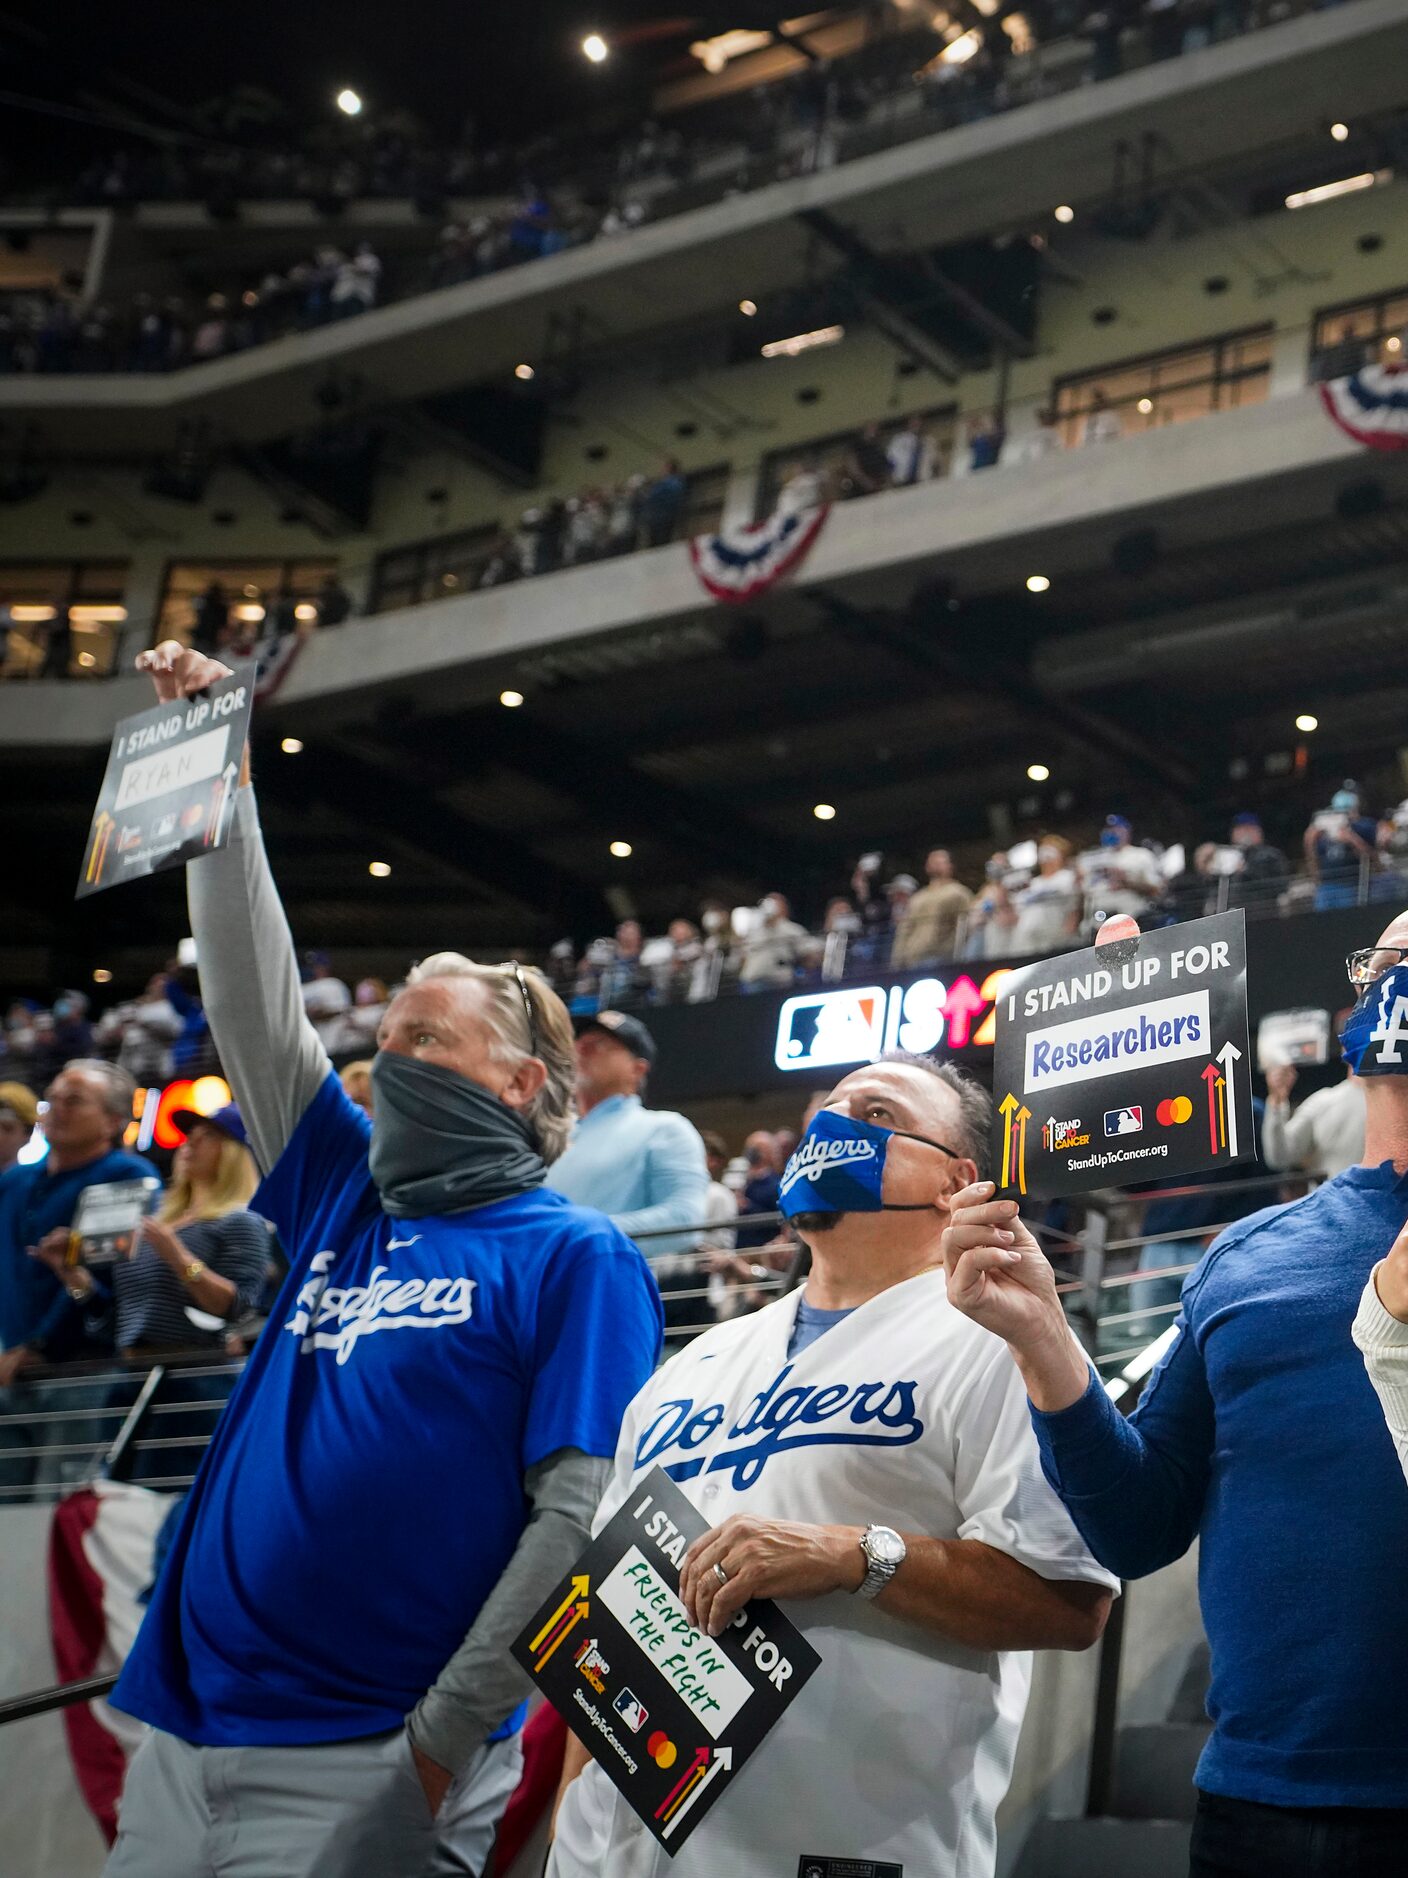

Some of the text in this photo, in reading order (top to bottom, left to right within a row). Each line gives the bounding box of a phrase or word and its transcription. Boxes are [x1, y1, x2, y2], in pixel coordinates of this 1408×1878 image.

[117, 687, 247, 759] I STAND UP FOR
[126, 755, 191, 797] RYAN
[1008, 941, 1231, 1022] I STAND UP FOR
[1032, 1014, 1201, 1077] Researchers
[1054, 1119, 1081, 1132] STAND
[1054, 1134, 1090, 1150] CANCER
[1055, 1128, 1077, 1141] UP TO
[1068, 1144, 1168, 1171] StandUpToCancer.org
[634, 1363, 924, 1491] Dodgers
[623, 1562, 725, 1675] FRIENDS IN
[633, 1495, 794, 1692] I STA P FOR
[629, 1609, 720, 1712] THE FIGHT
[573, 1688, 638, 1774] StandUpToCancer.org
